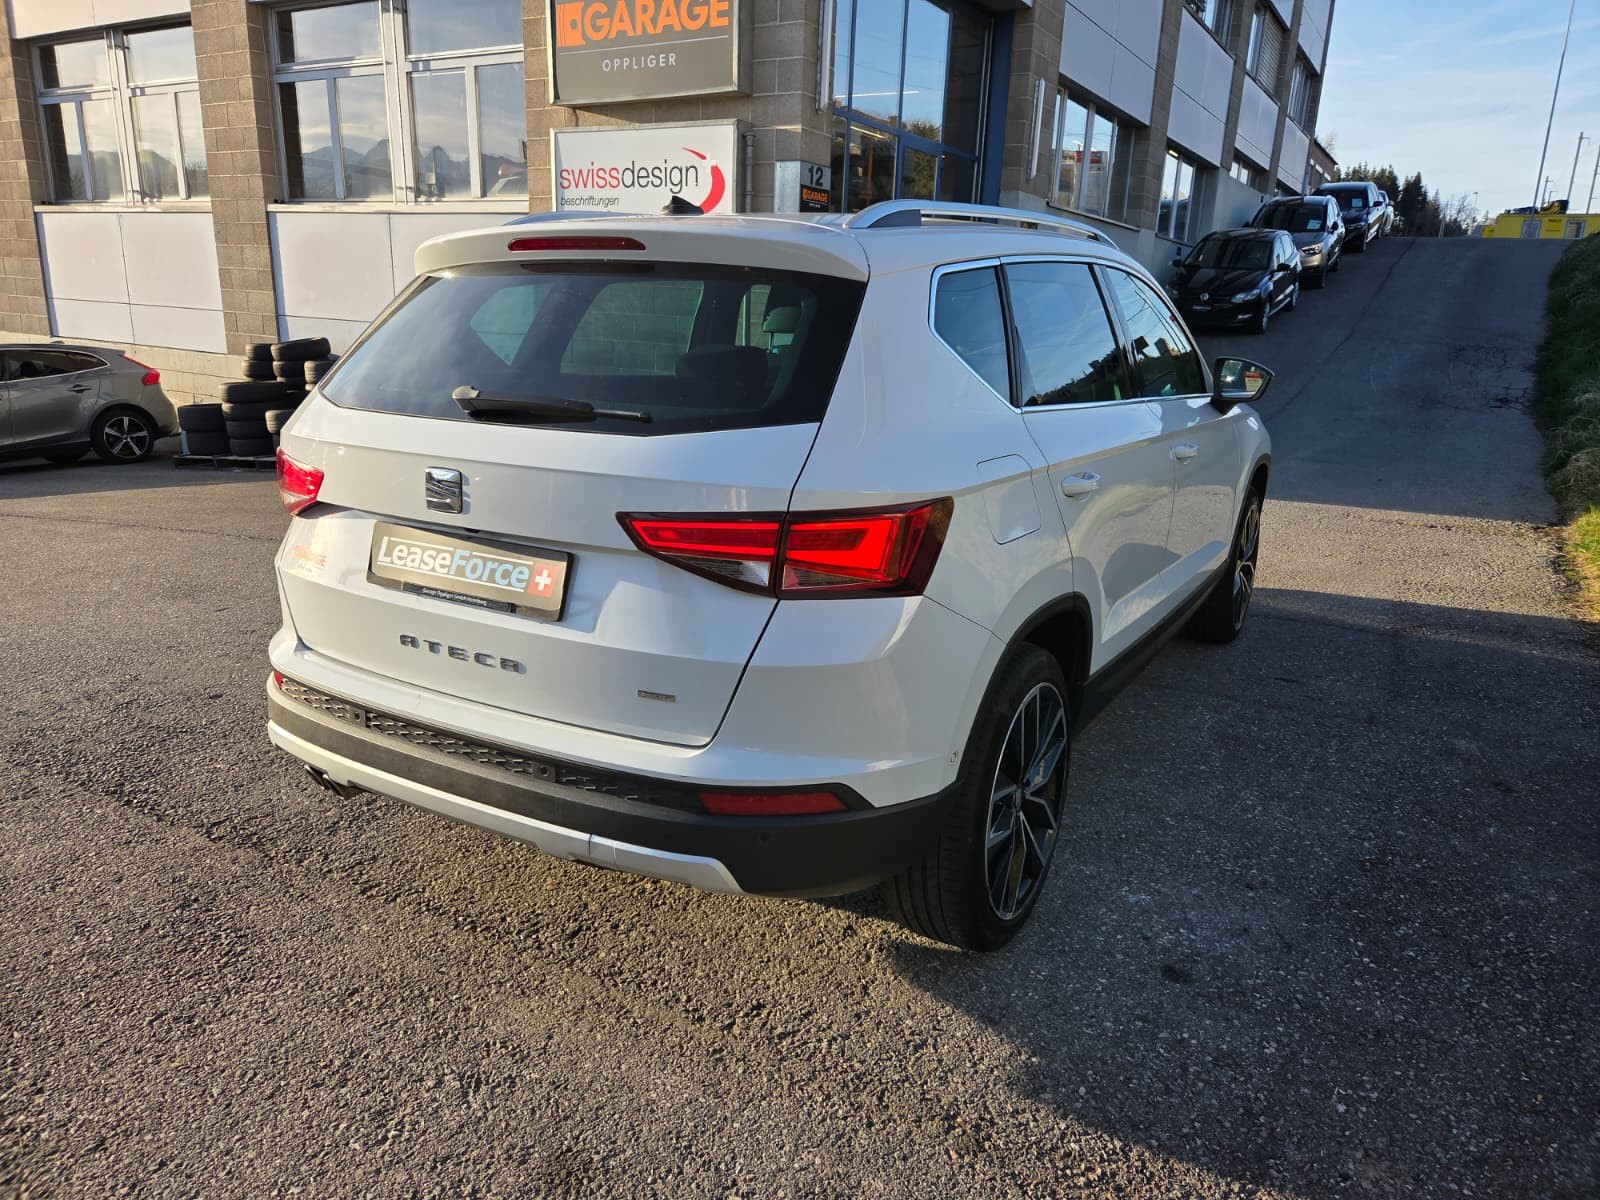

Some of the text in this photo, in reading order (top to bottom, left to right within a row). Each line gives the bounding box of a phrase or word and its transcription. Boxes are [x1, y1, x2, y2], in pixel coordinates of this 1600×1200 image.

[584, 0, 730, 42] GARAGE
[602, 52, 678, 73] OPPLIGER
[559, 158, 700, 195] swissdesign
[808, 165, 824, 187] 12
[560, 195, 620, 209] beschriftungen
[376, 535, 530, 589] LeaseForce
[399, 634, 523, 674] ATECA
